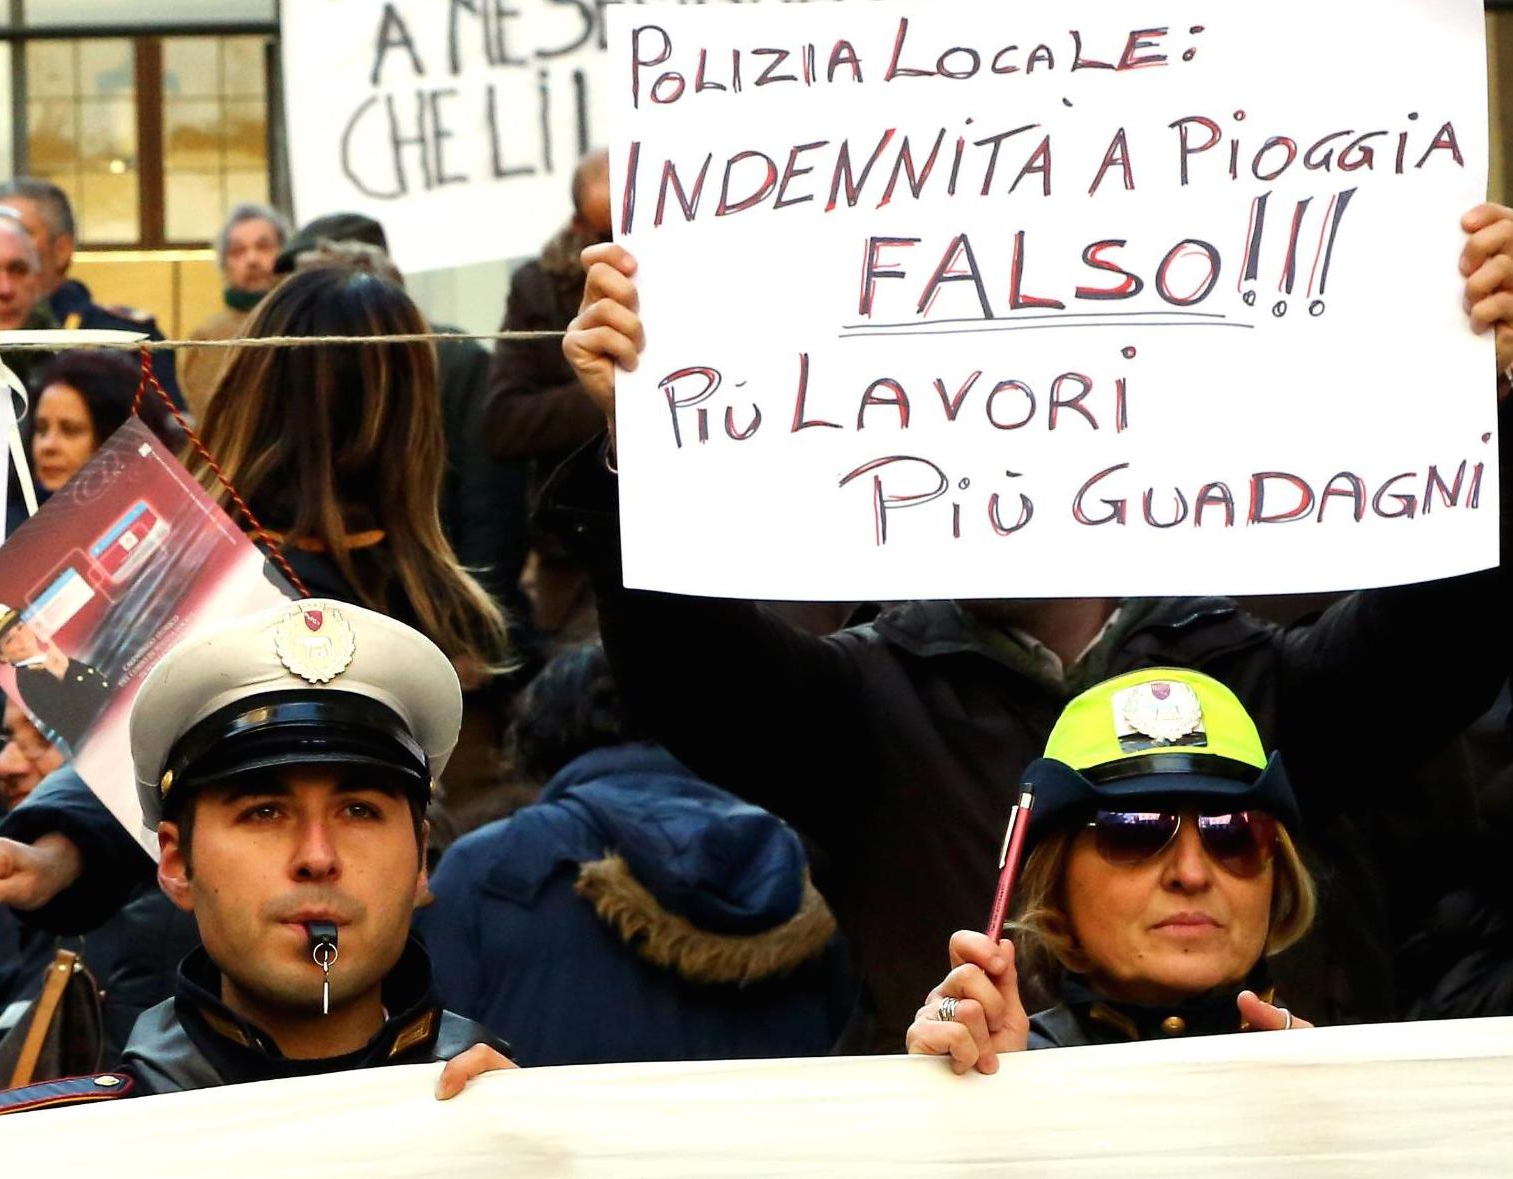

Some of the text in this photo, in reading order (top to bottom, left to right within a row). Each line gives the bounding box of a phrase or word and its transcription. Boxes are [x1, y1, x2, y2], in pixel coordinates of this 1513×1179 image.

[371, 1, 425, 86] A
[631, 16, 1206, 109] POLIZIA LOCALE:
[341, 88, 469, 200] CHE
[1087, 126, 1136, 198] A
[858, 187, 1358, 319] FALSO!!!
[789, 345, 1138, 434] LAVORI
[1071, 431, 1493, 529] GUADAGNI
